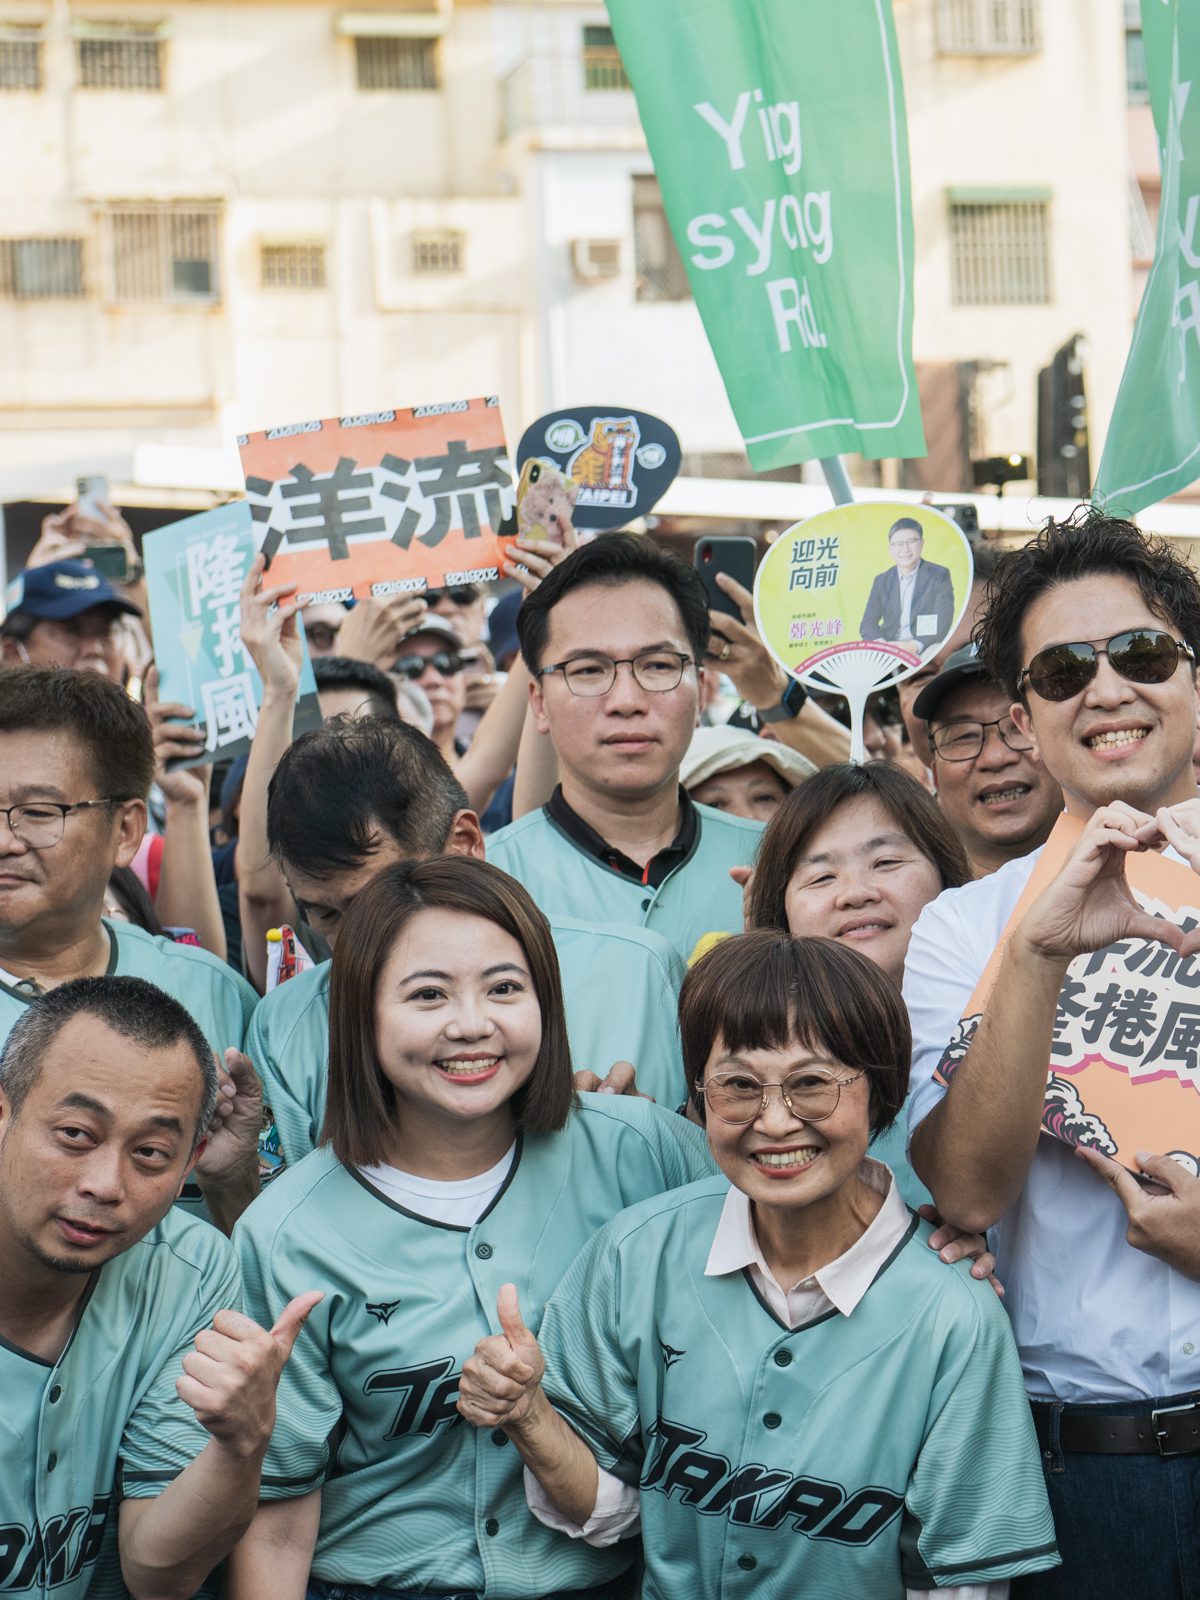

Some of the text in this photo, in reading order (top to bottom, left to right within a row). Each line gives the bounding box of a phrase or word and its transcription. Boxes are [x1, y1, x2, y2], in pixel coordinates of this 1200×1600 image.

[246, 440, 518, 571] 洋流
[576, 488, 628, 505] AIPEI
[791, 537, 839, 564] 迎光
[789, 563, 839, 590] 向前
[639, 1417, 906, 1548] TAKAO
